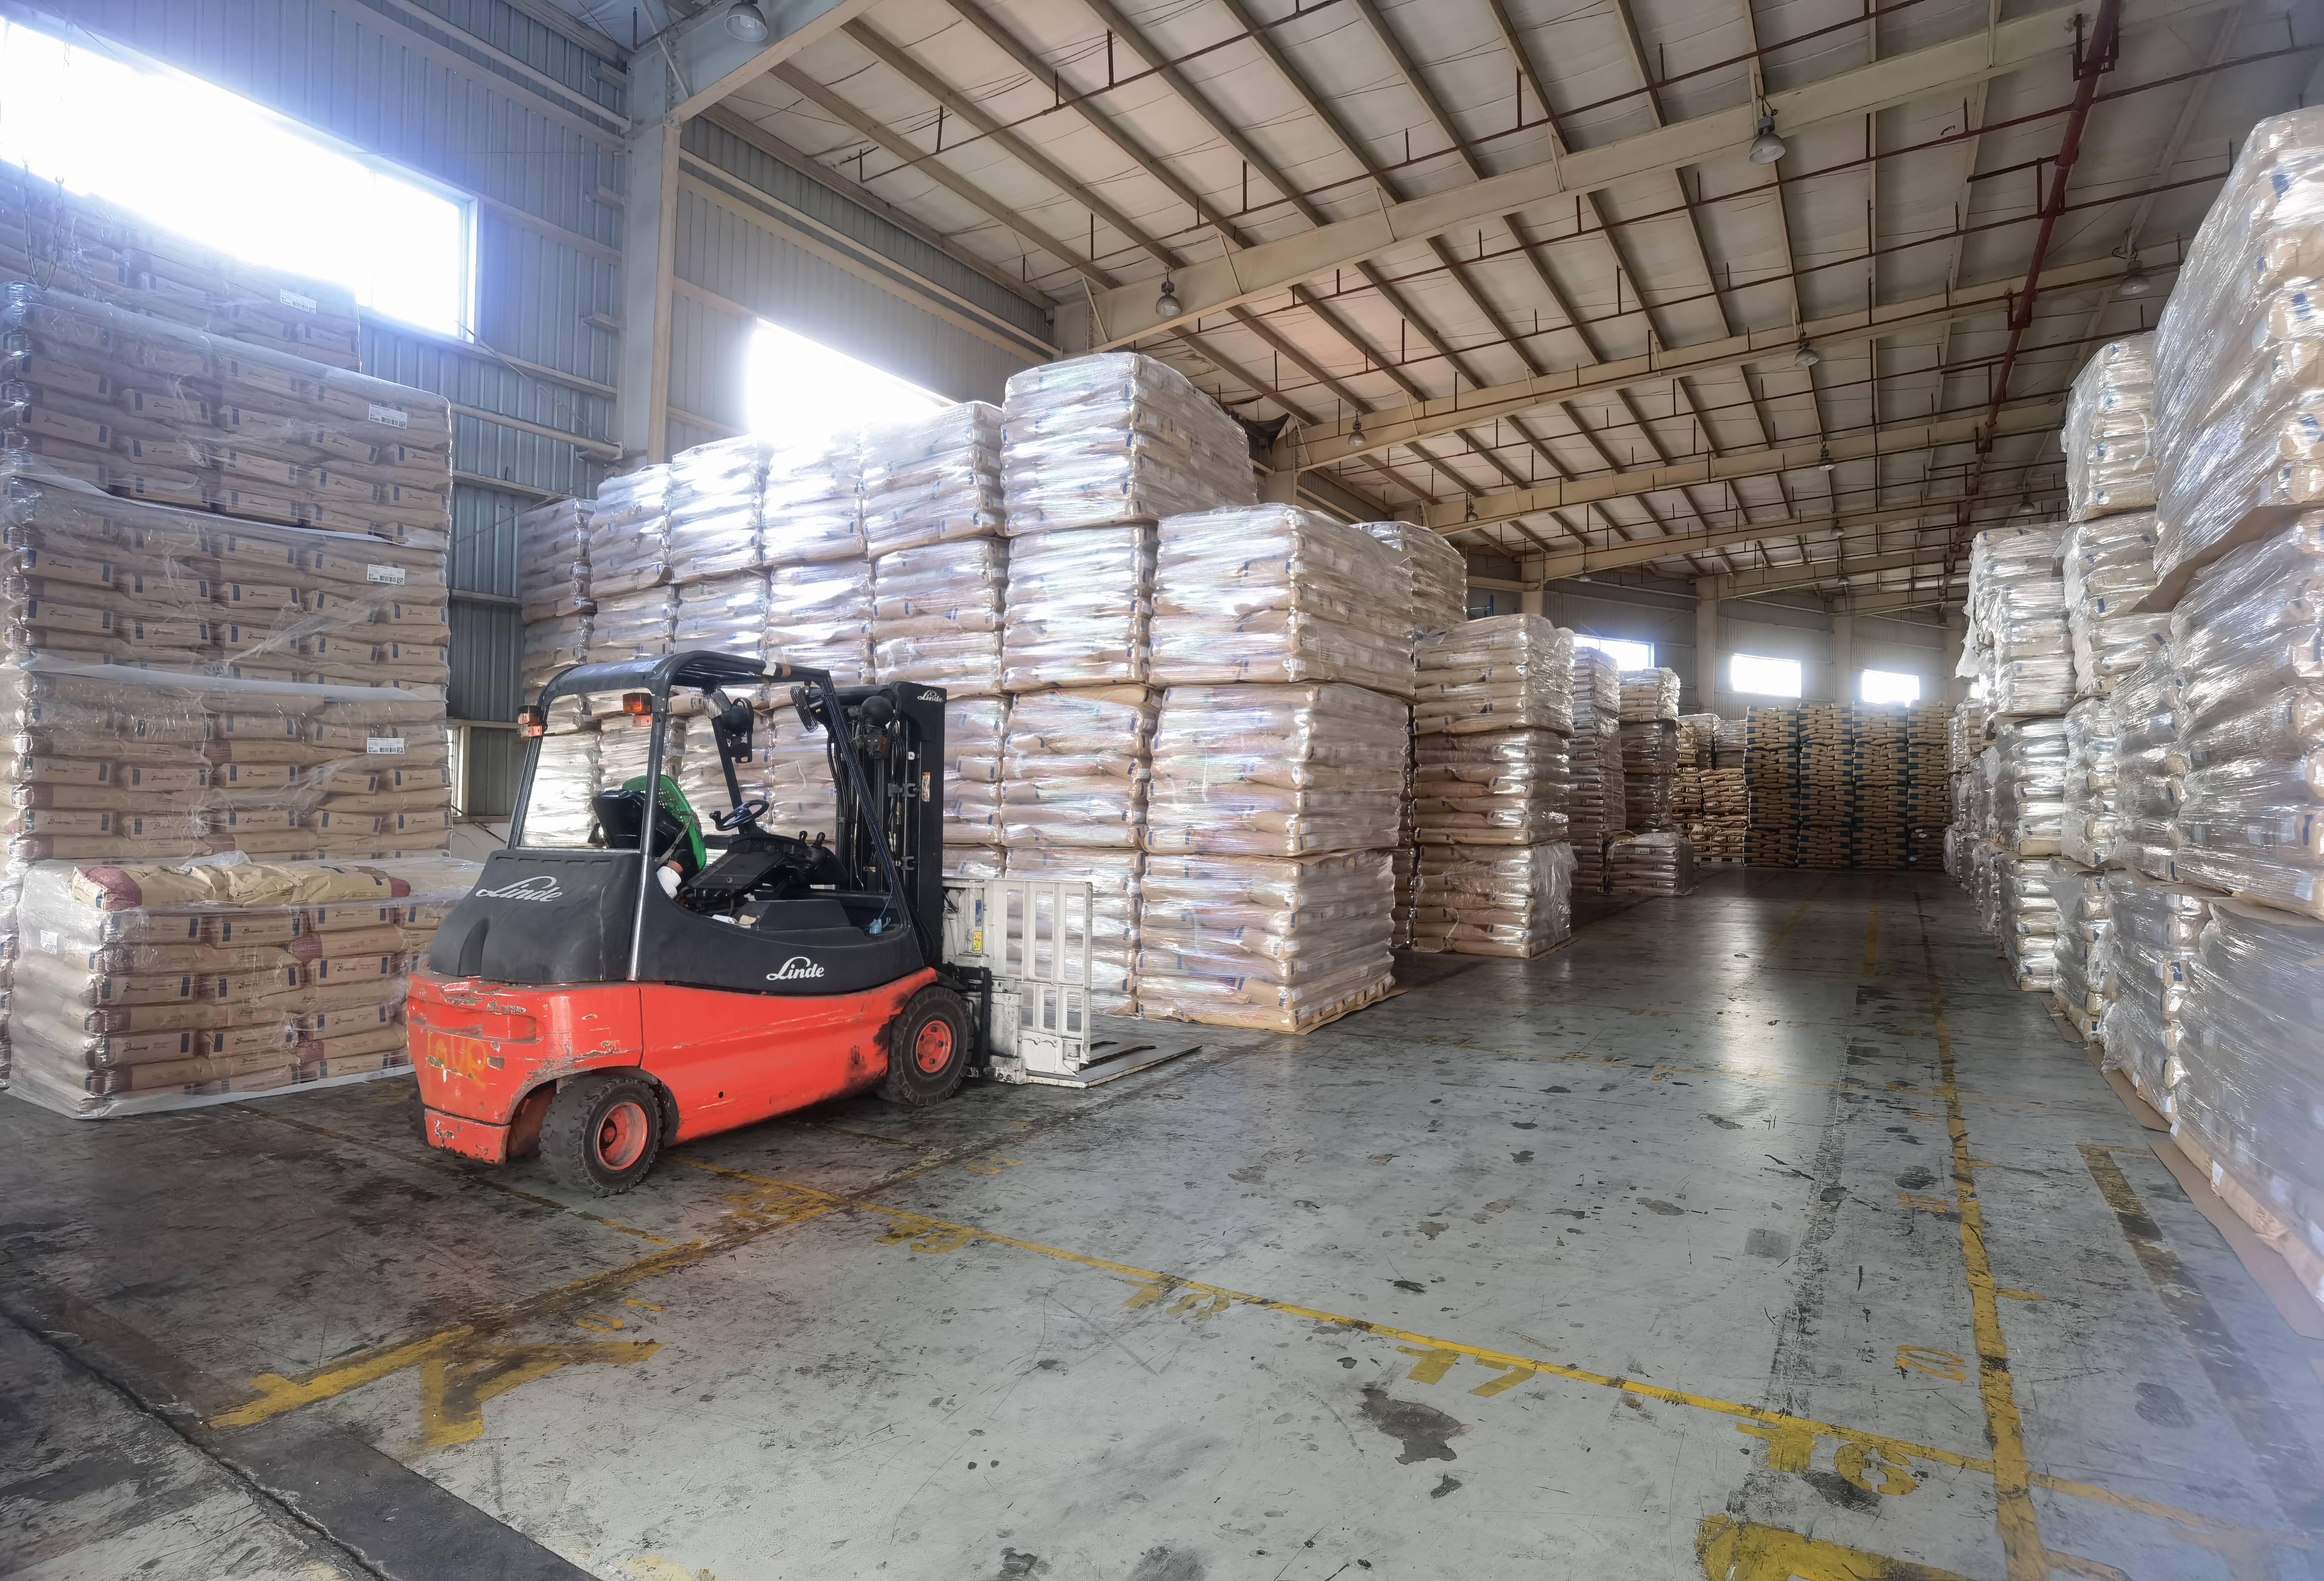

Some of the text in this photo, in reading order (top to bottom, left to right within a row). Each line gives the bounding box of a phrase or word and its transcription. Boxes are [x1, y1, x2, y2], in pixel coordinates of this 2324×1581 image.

[917, 690, 944, 702] Linde
[475, 876, 563, 902] Linde
[766, 956, 824, 980] Linde
[875, 1220, 973, 1254] 19
[1396, 1346, 1537, 1398] 17
[1735, 1422, 1918, 1496] 16
